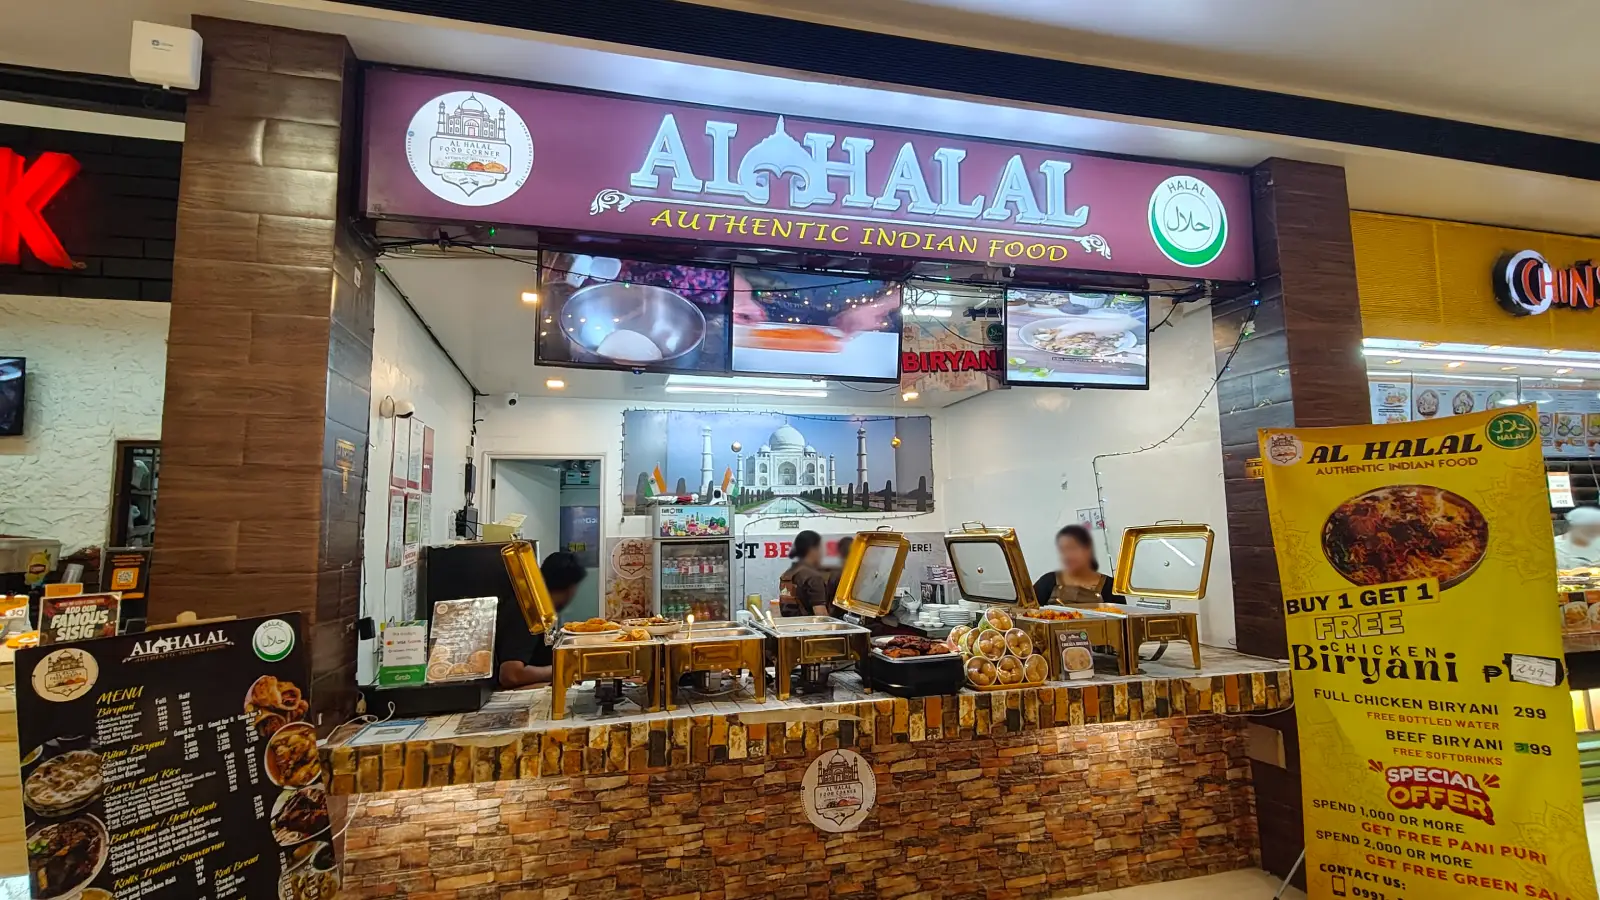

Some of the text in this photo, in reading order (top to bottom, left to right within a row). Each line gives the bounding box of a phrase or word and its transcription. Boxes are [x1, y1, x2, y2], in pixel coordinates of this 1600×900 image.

[1167, 178, 1206, 199] HALAL
[1166, 206, 1212, 234] حلال
[651, 209, 1069, 262] AUTHENTIC INDIAN FOOD
[1307, 433, 1483, 465] AL HALAL
[1496, 432, 1527, 442] HALAL
[1315, 456, 1479, 476] AUTHENTIC INDIAN FOOD
[910, 544, 932, 552] ERE!
[65, 606, 80, 614] ADD
[1286, 583, 1433, 614] BUY 1 GET 1
[50, 610, 109, 629] FAMOUS
[1314, 610, 1405, 640] FREE
[56, 625, 95, 641] SISIG
[1330, 642, 1437, 658] CHICKEN
[1292, 644, 1458, 685] Biryani
[96, 685, 144, 705] MENU
[1314, 688, 1546, 720] FULL CHICKEN BIRYANI 299
[1366, 712, 1500, 731] FREE BOTTLED WATER
[1386, 730, 1426, 742] BEEF
[1432, 734, 1503, 751] BIRYANI
[1393, 748, 1503, 766] FREE SOFTDRINKS
[1387, 768, 1483, 794] SPECIAL
[1388, 786, 1487, 816] OFFER
[1313, 799, 1356, 814] SPEND
[1400, 814, 1418, 827] OR
[1423, 819, 1465, 834] MORE
[1316, 830, 1360, 846] SPEND
[1406, 848, 1426, 860] OR
[1431, 853, 1473, 869] MORE
[1362, 822, 1548, 866] GET FREE PANI PURI
[1320, 863, 1406, 890] CONTACT US:
[1366, 854, 1397, 871] GET
[1402, 862, 1448, 881] FREE
[1453, 872, 1519, 894] GREEN
